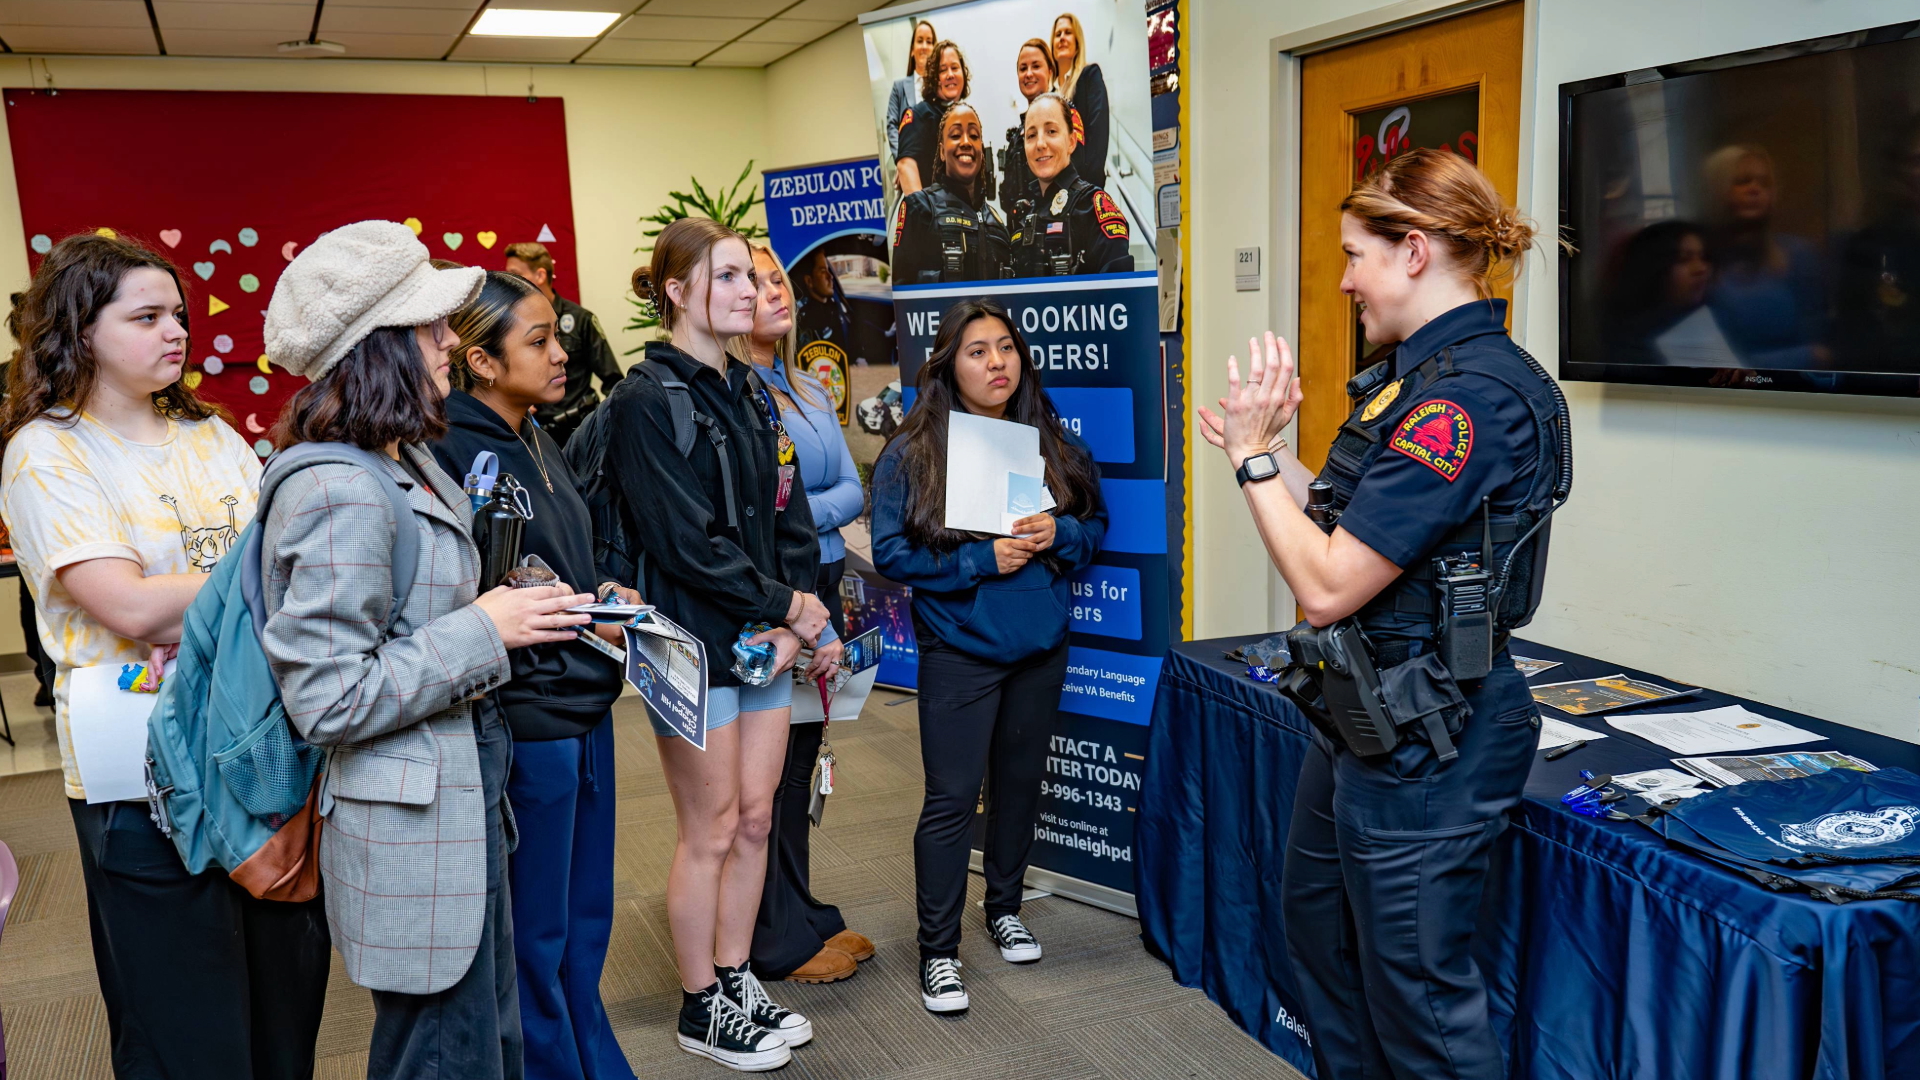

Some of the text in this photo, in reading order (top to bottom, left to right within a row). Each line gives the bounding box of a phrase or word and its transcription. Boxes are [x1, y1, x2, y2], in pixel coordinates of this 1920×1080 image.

[769, 168, 856, 198] ZEBULON
[1239, 252, 1253, 263] 221
[906, 310, 940, 336] WE
[803, 346, 841, 363] ZEBULON
[1745, 375, 1773, 384] INSIGNIA
[1052, 413, 1082, 437] ng
[1402, 403, 1446, 432] RALEIGH
[1453, 413, 1470, 458] POLICE
[1395, 437, 1457, 475] CAPITAL CITY
[1072, 580, 1128, 601] us for
[1069, 606, 1103, 622] ers
[1066, 665, 1146, 686] ondary Language
[1085, 685, 1098, 696] VA
[1099, 688, 1136, 703] Benefits
[661, 693, 697, 730] Chapel Hill
[678, 700, 698, 722] Police
[682, 722, 697, 738] Join
[1104, 745, 1118, 764] A
[1084, 762, 1142, 792] TODAY
[1040, 780, 1122, 812] 9-996-1343
[1040, 812, 1108, 836] visit us online at
